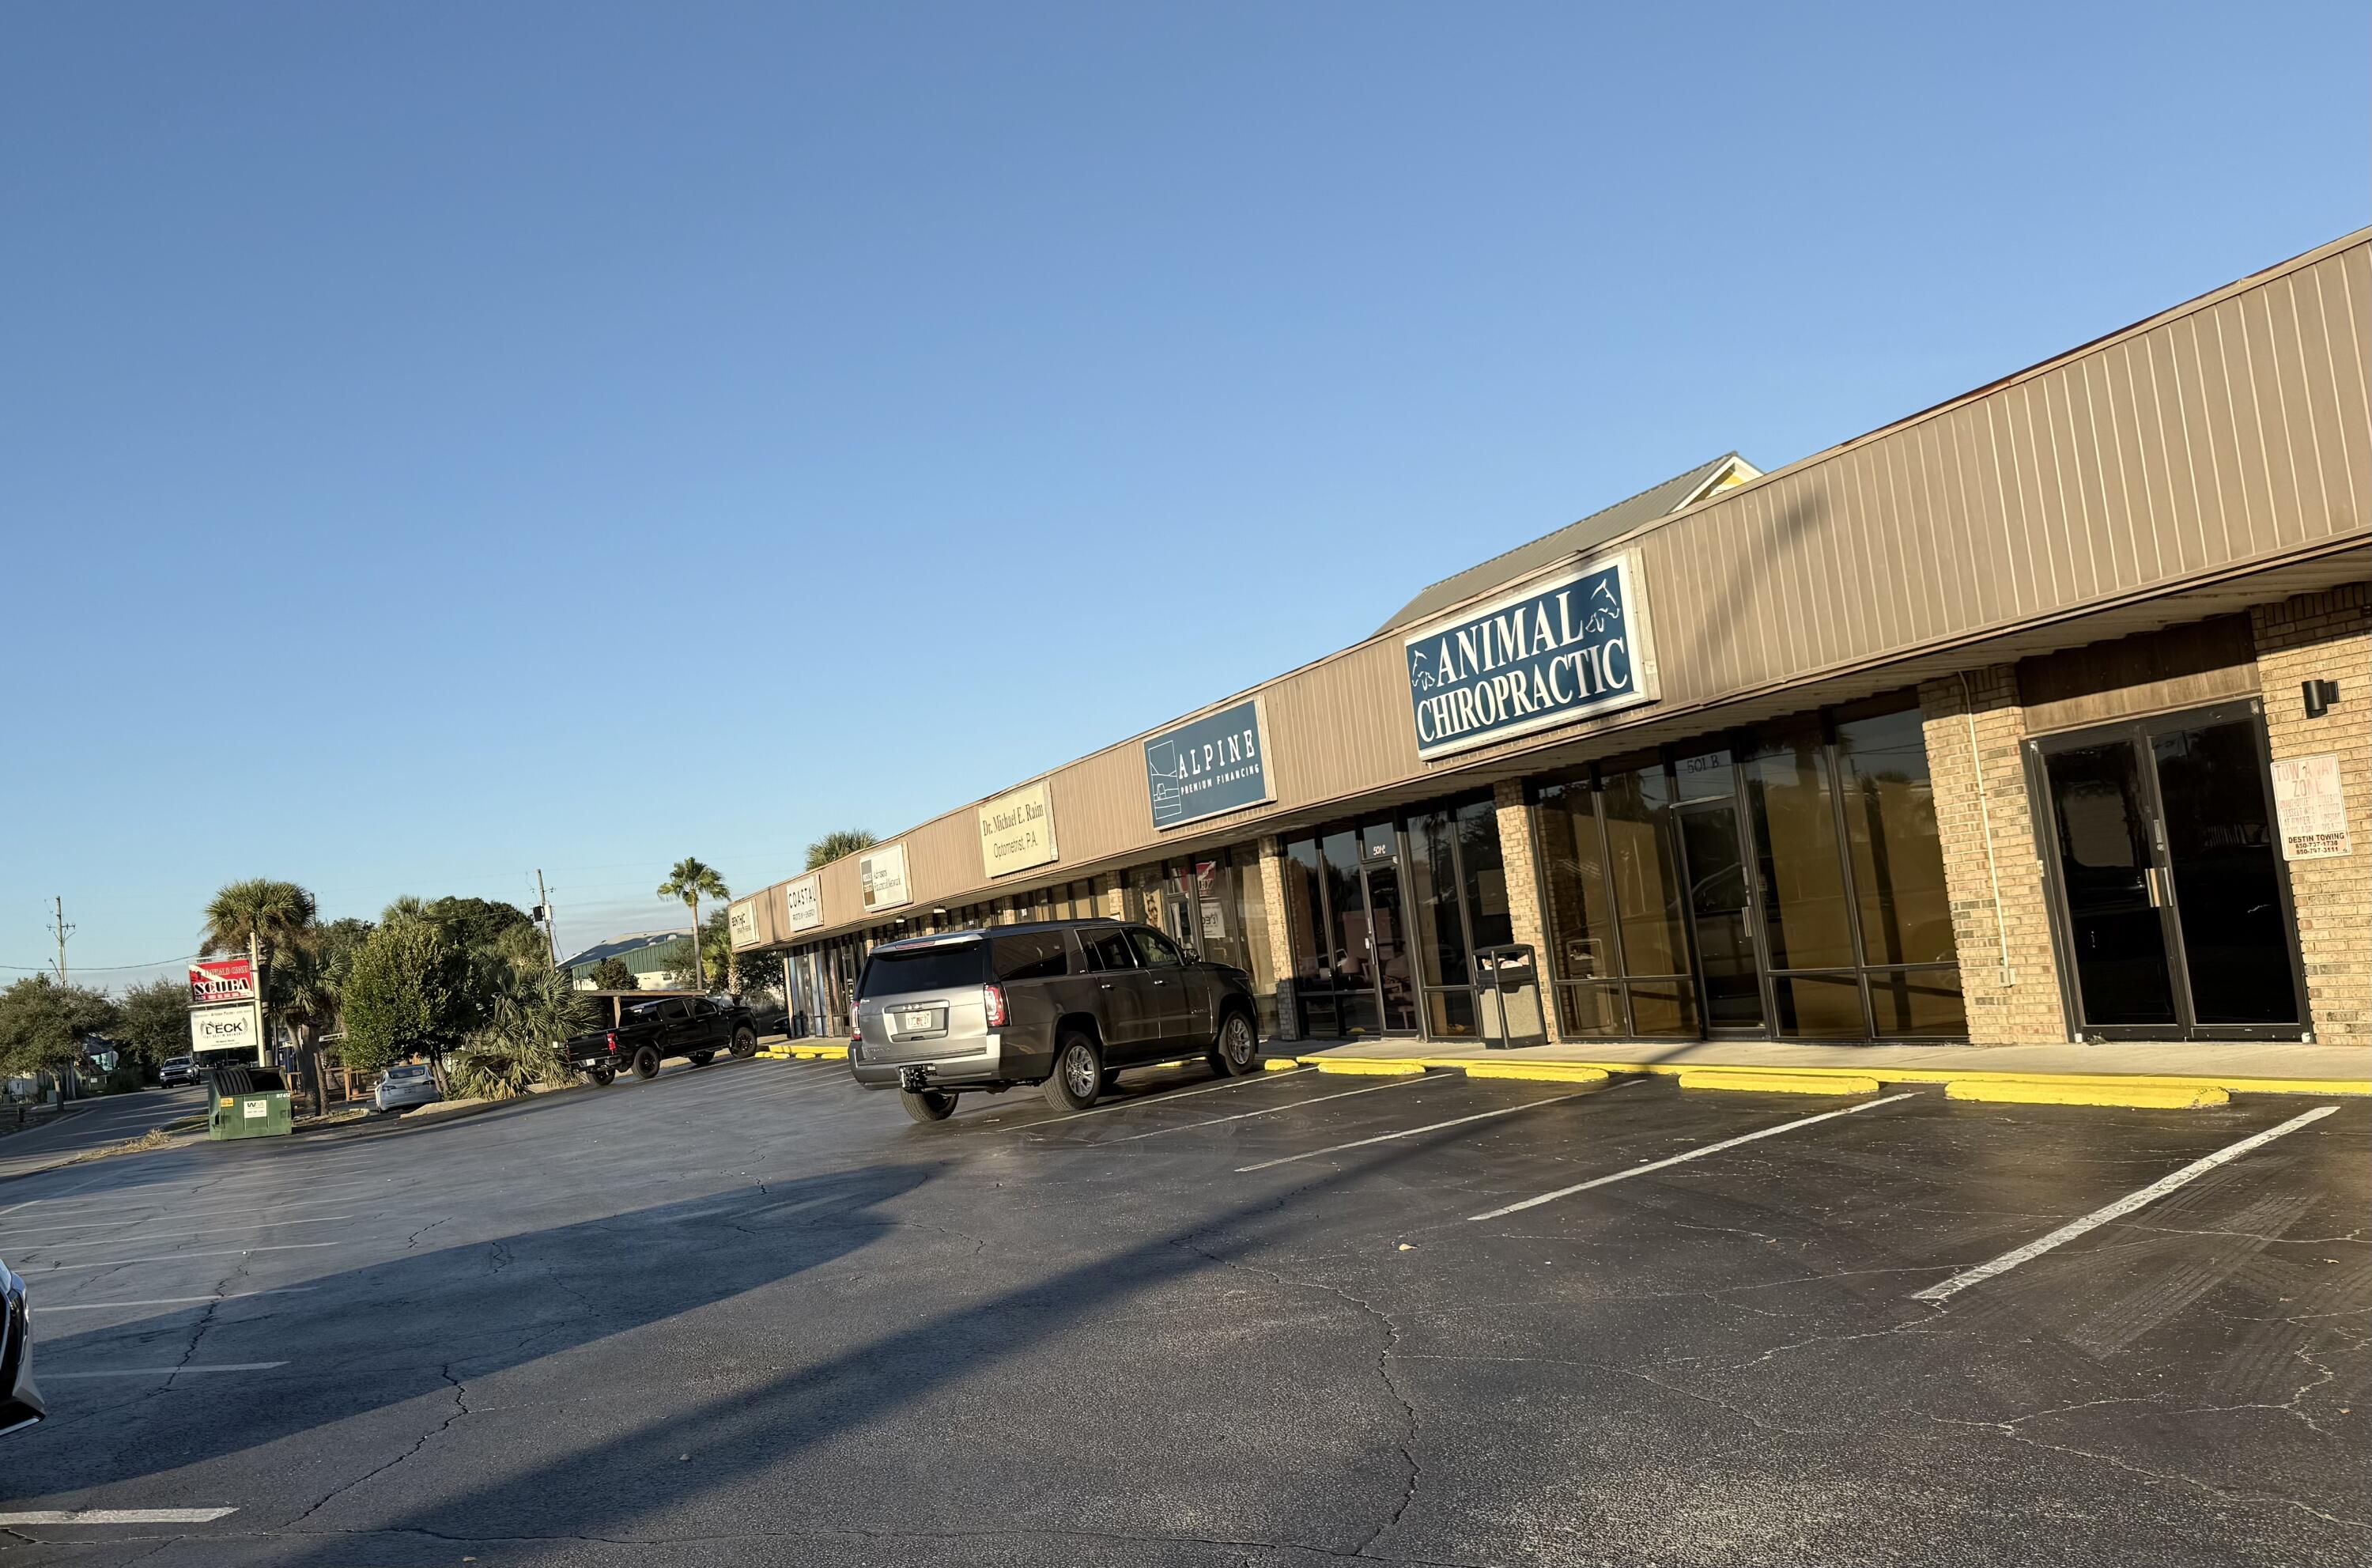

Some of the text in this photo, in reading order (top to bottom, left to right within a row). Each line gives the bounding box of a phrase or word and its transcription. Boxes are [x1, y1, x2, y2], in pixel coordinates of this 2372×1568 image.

[1437, 591, 1584, 687] ANIMAL
[1417, 637, 1628, 742] CHIROPRACTIC
[1179, 729, 1255, 780] ALPINE
[1687, 758, 1707, 773] 501
[2275, 764, 2299, 781] TOW
[1180, 764, 1260, 795] PREMIUM FINANCING
[2292, 780, 2323, 797] ZONE
[983, 801, 1044, 837] Dr. Michael E. Raim
[2288, 833, 2344, 844] DESTIN TOWING
[788, 886, 816, 909] COASTAL
[193, 977, 251, 996] SCUBA
[206, 1022, 243, 1035] DECK
